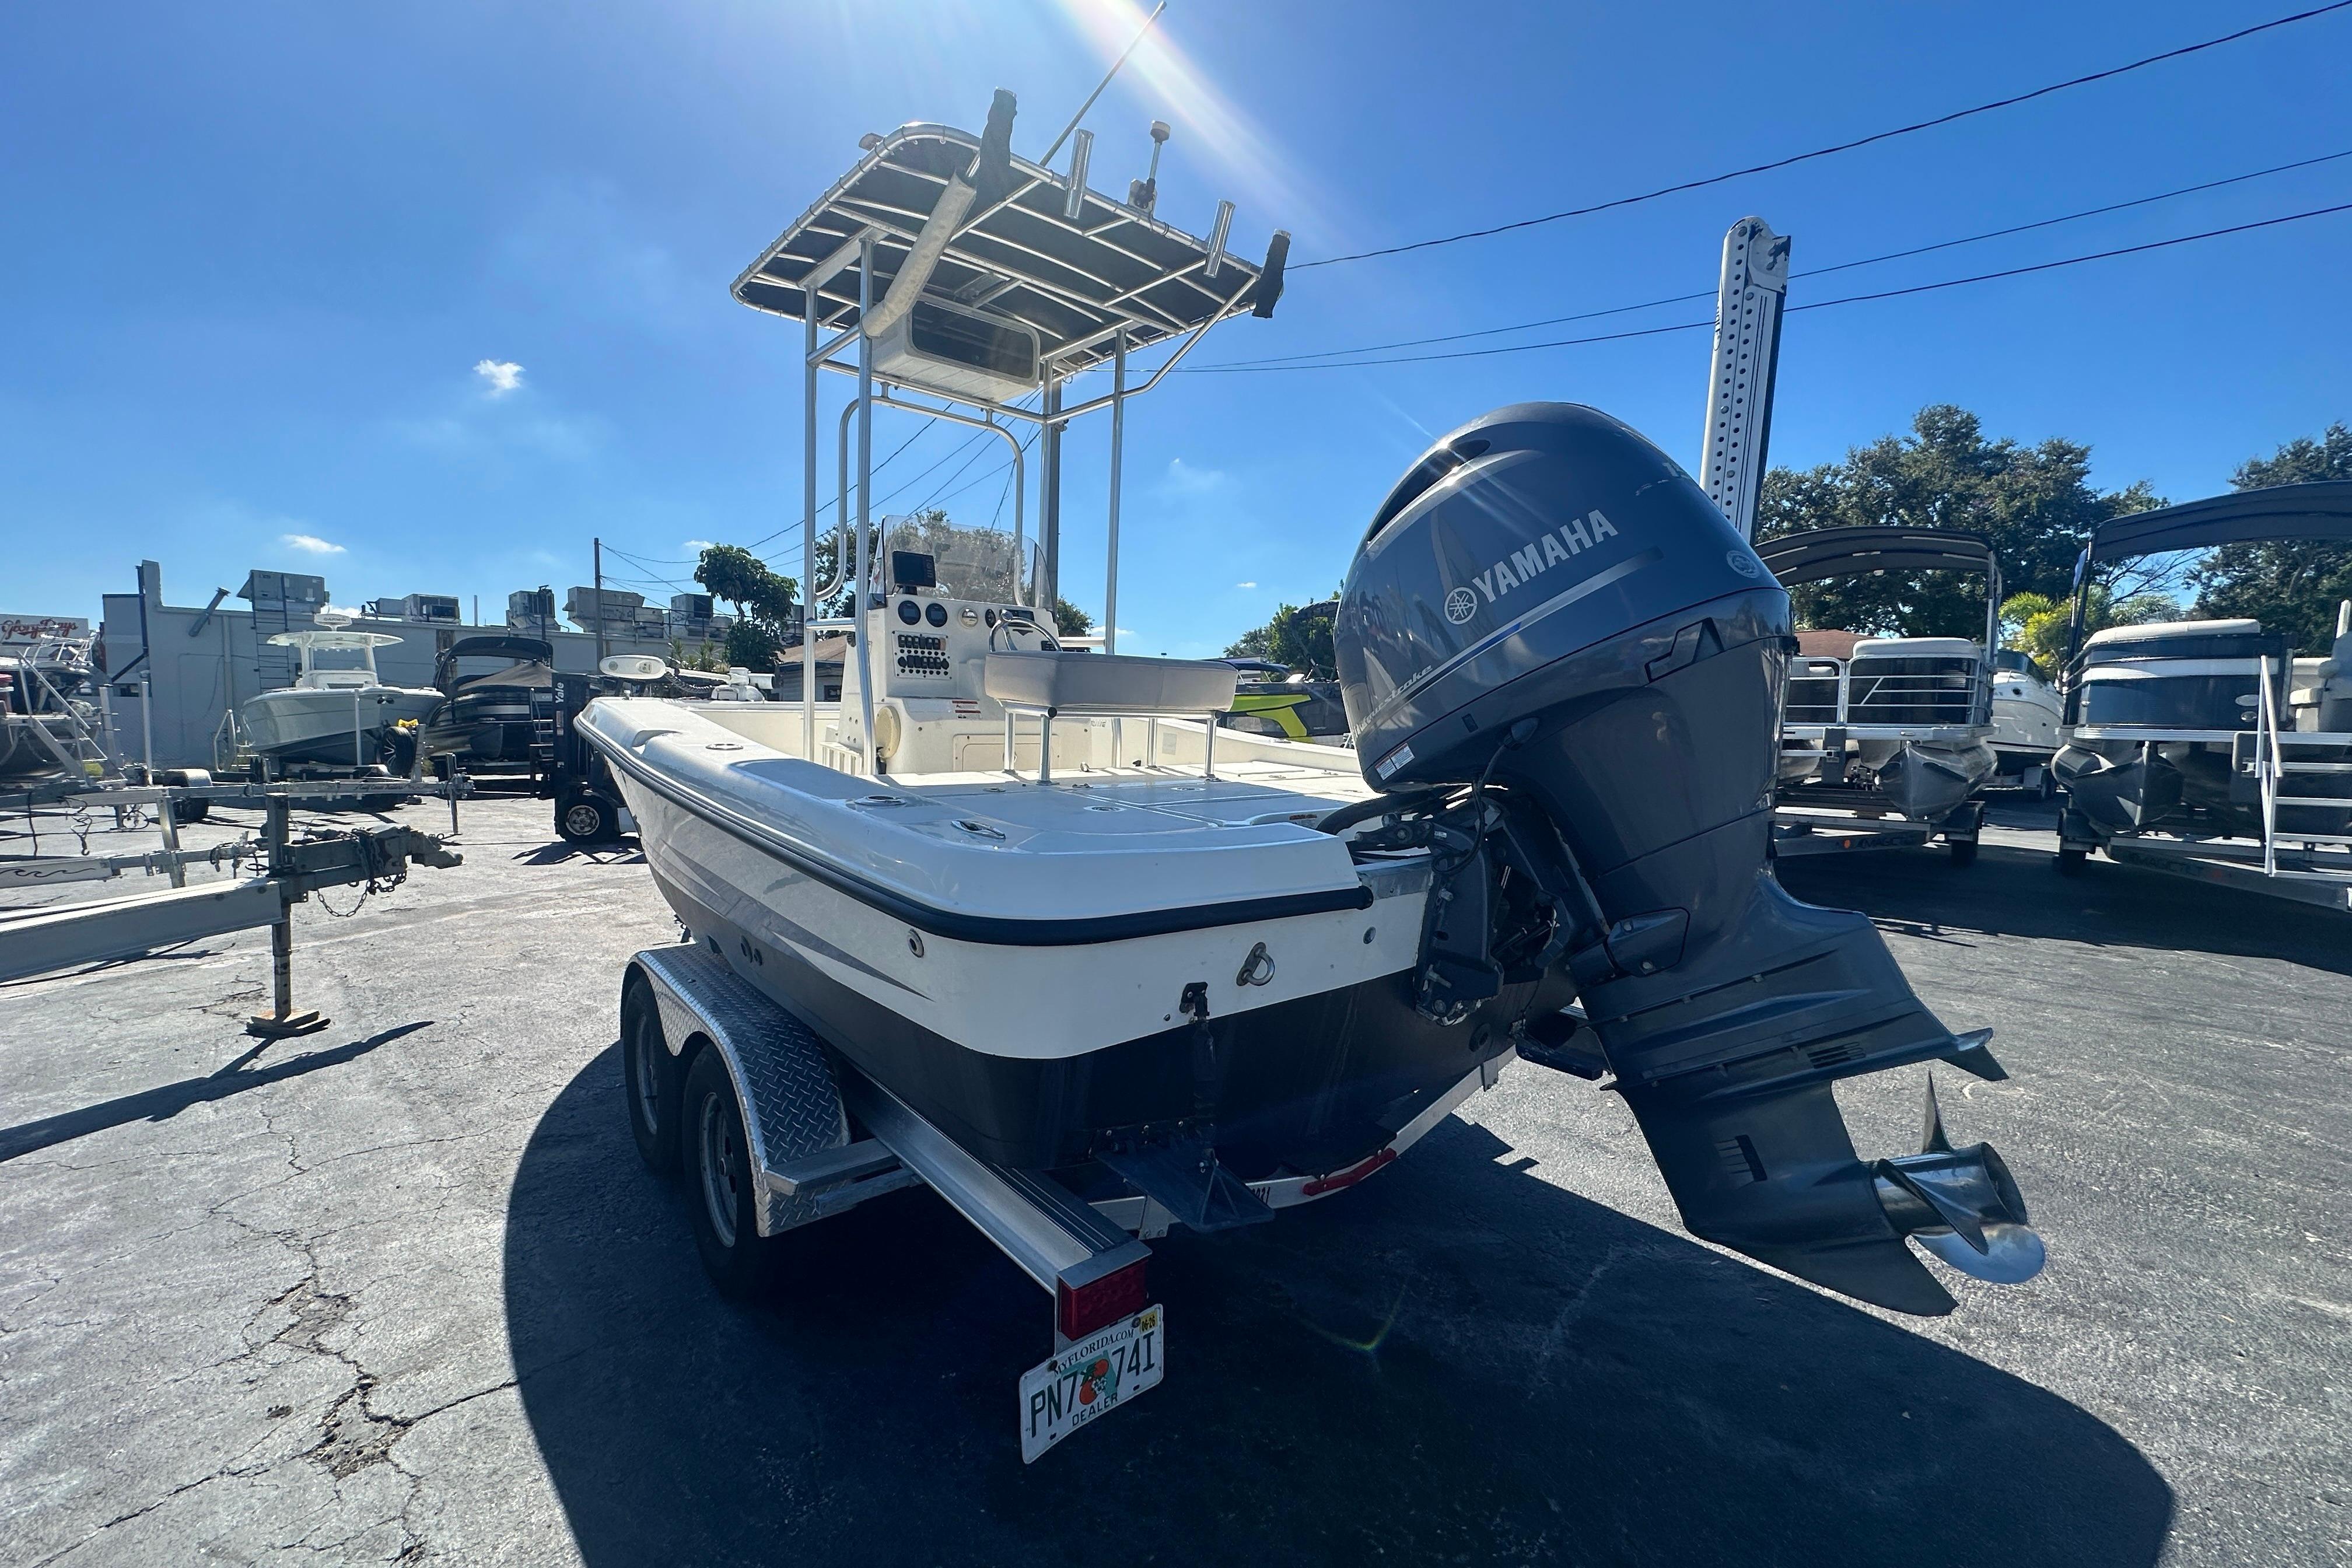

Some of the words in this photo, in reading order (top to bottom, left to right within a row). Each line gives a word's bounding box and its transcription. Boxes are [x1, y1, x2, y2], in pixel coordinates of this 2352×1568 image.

[1472, 509, 1618, 603] YAMAHA
[2, 620, 39, 639] Glory
[40, 618, 78, 637] Days
[555, 682, 564, 704] Yale
[1054, 1329, 1135, 1377] MYFLORIDA.COM
[1031, 1373, 1078, 1438] PN7
[1112, 1331, 1155, 1388] 74I
[1072, 1392, 1118, 1427] DEALER
